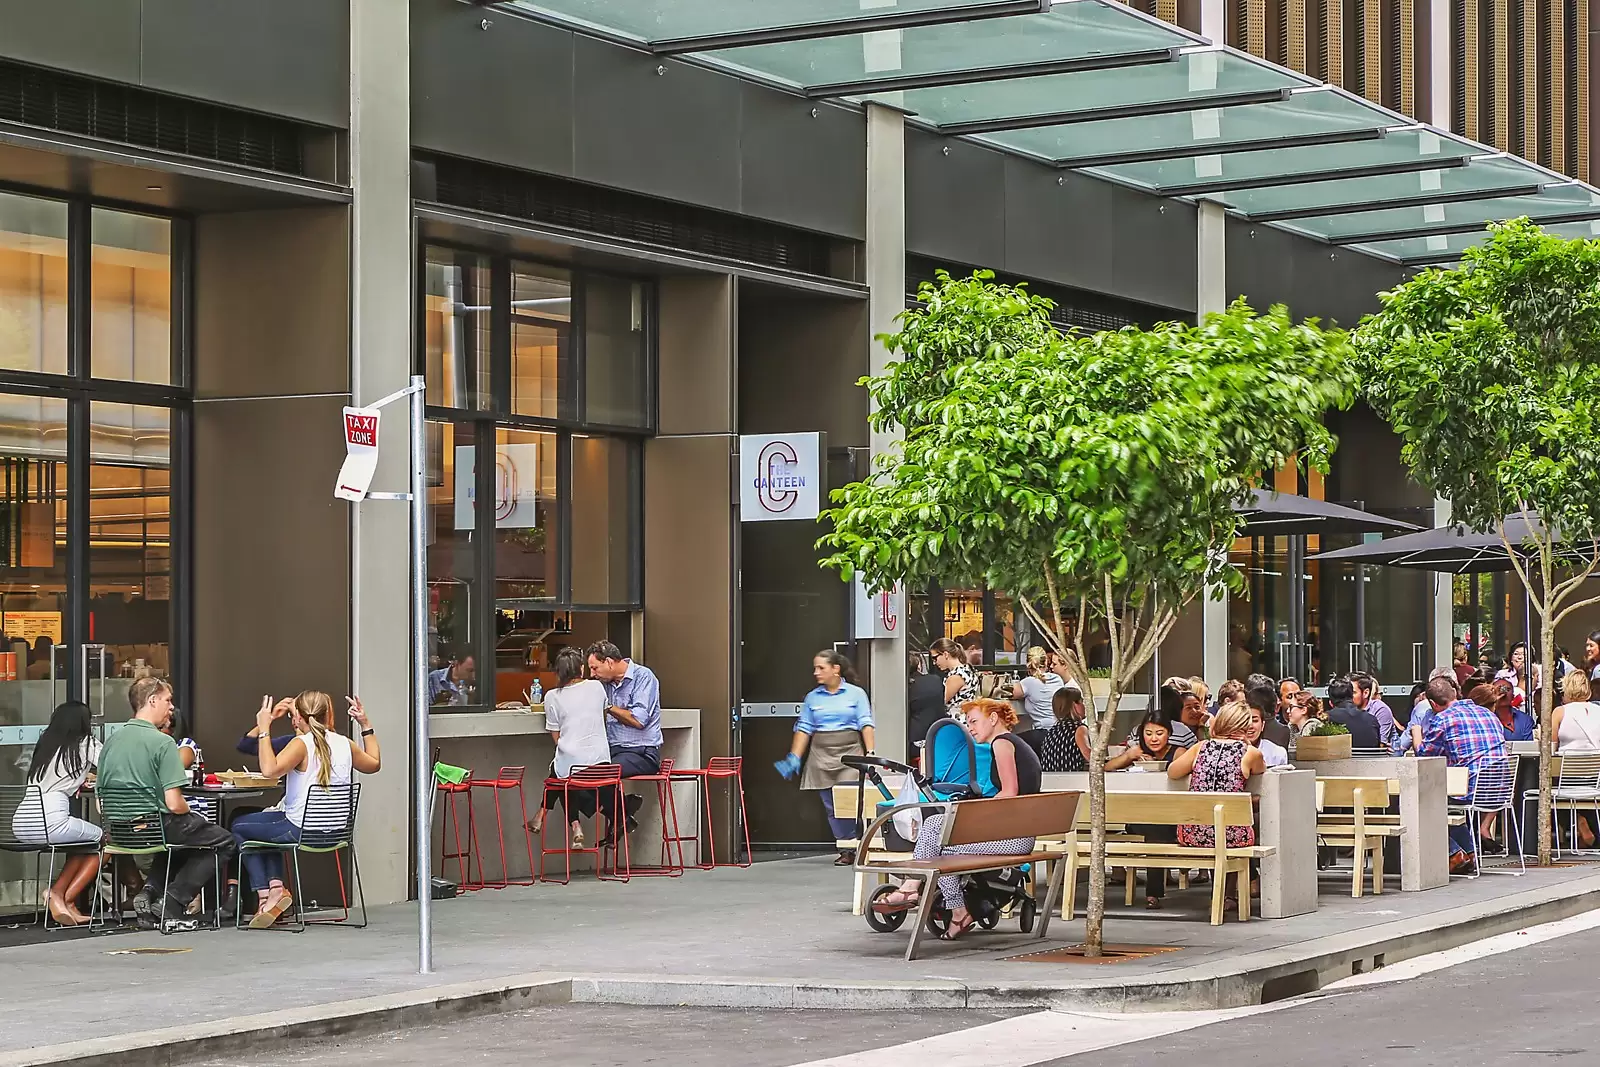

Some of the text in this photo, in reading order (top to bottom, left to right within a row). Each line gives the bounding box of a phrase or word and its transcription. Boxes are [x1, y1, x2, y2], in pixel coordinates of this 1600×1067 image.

[348, 415, 375, 430] TAXI
[350, 430, 373, 445] ZONE
[769, 464, 791, 475] THE
[753, 476, 806, 489] CANTEEN
[758, 441, 798, 513] C
[770, 705, 776, 714] C
[795, 705, 801, 714] C
